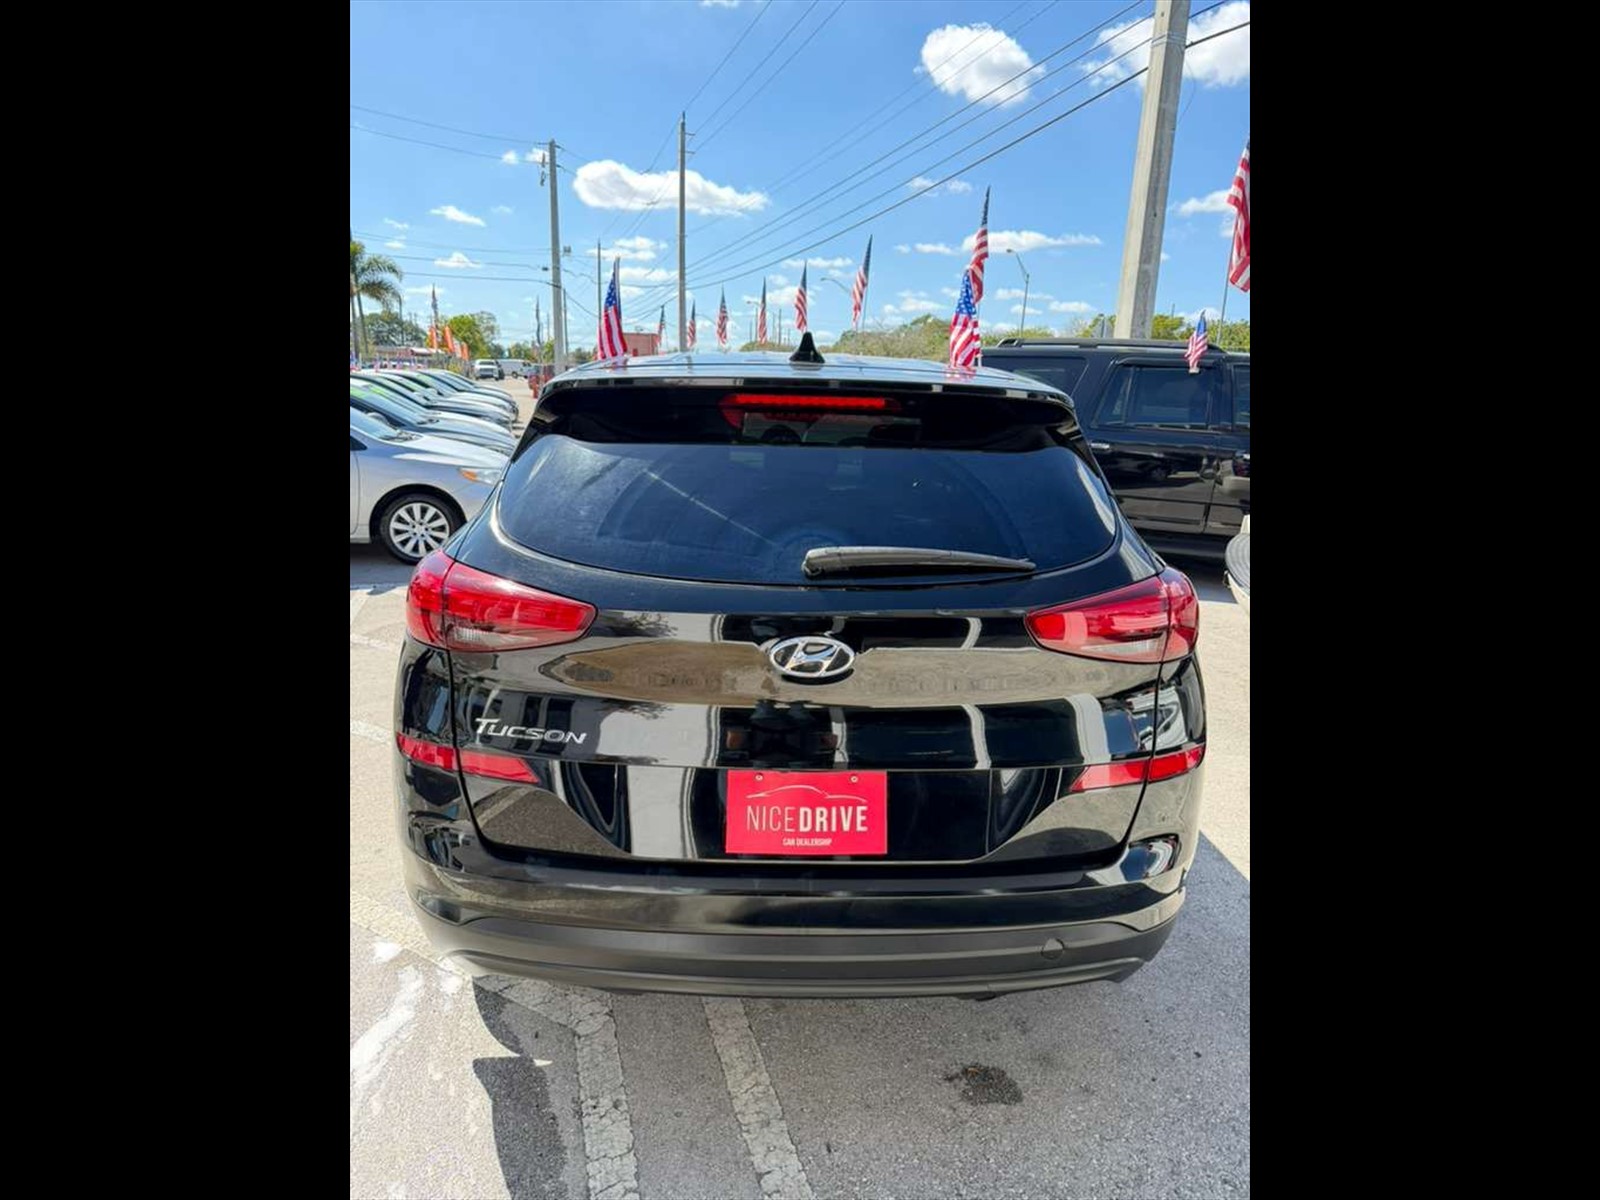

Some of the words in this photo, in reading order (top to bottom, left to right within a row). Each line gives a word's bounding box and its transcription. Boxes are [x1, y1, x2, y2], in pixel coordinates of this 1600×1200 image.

[475, 717, 588, 744] TUCSON
[782, 837, 795, 847] CAR
[796, 837, 832, 847] DEALERSHIP
